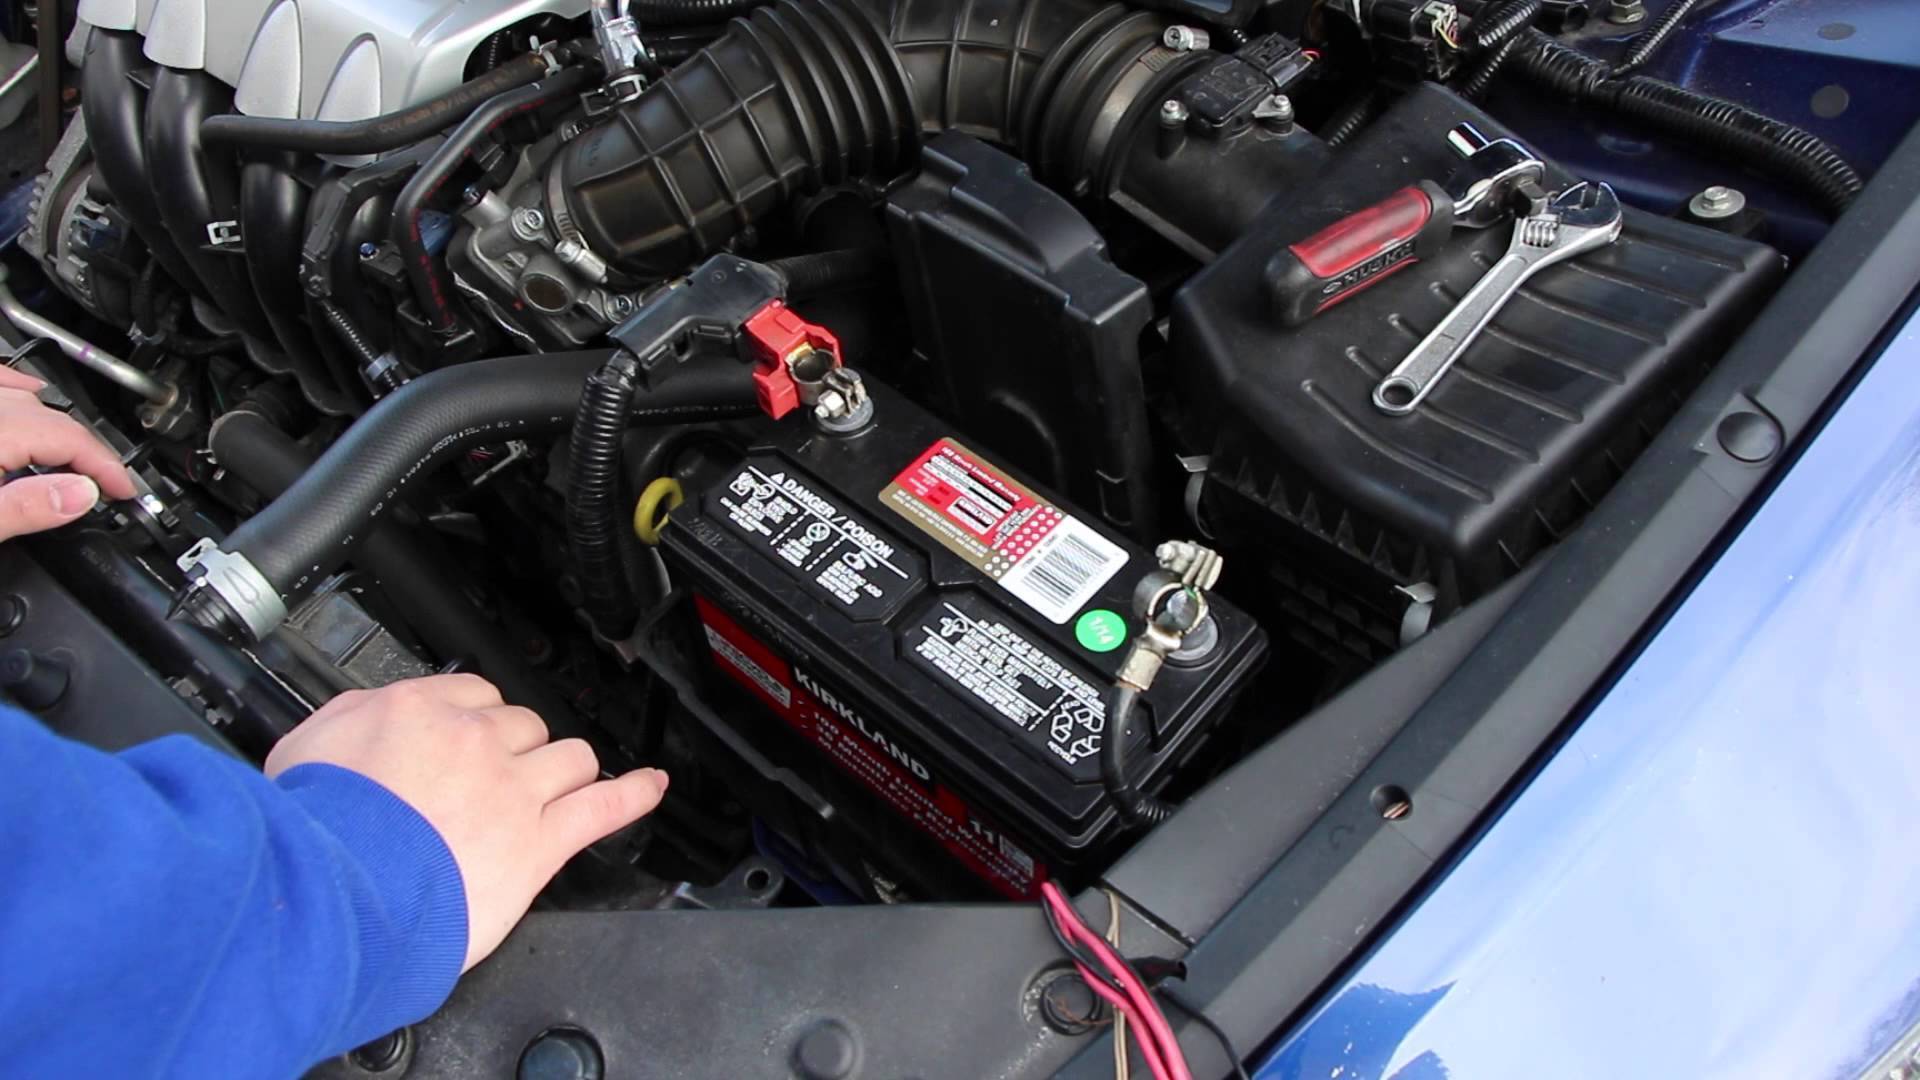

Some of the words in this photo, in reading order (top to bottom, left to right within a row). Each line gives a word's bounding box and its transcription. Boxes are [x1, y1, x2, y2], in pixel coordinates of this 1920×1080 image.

[783, 479, 836, 519] DANGER
[842, 520, 894, 560] POISON
[795, 667, 930, 781] KIRKLAND
[843, 735, 891, 776] Month
[895, 777, 953, 824] Limited
